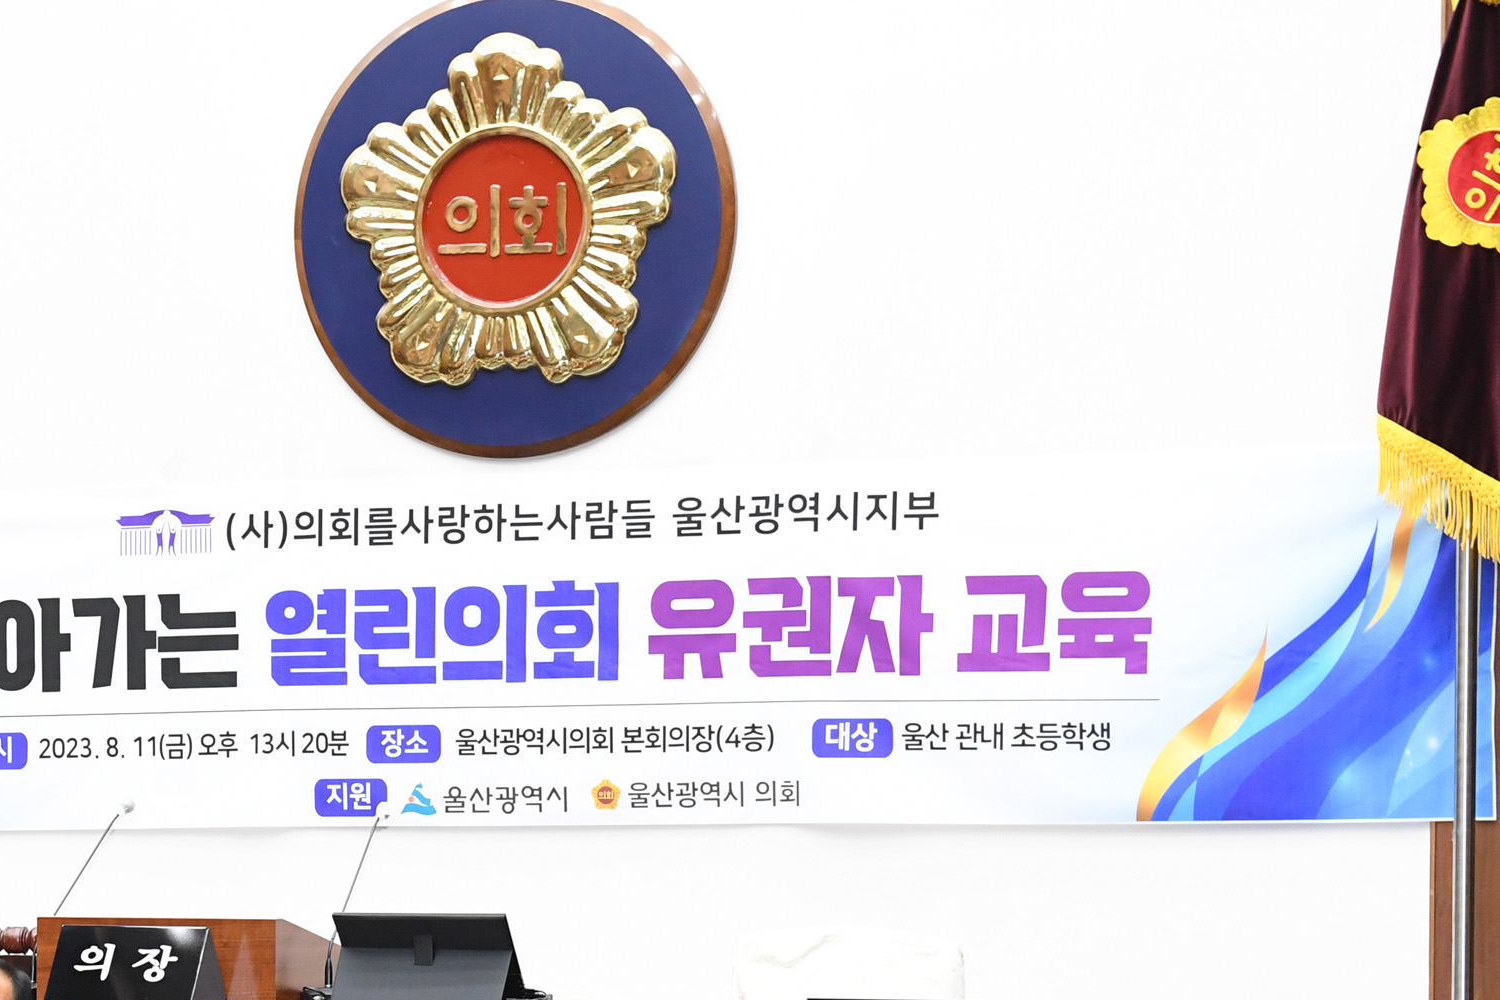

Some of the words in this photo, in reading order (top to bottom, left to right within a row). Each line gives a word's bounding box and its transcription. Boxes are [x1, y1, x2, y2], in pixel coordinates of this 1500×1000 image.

[437, 182, 567, 258] 의회
[226, 499, 656, 551] (사)의회를사랑하는사람들
[672, 490, 940, 537] 울산광역시지부
[265, 580, 619, 687] 열린의회
[647, 574, 935, 680] 유권자
[956, 570, 1153, 675] 교육
[38, 737, 100, 759] 2023.
[106, 737, 126, 758] 8.
[133, 733, 193, 761] 11(금)
[198, 731, 239, 757] 오후
[250, 730, 295, 757] 13시
[301, 730, 350, 757] 20분
[380, 728, 429, 758] 장소
[455, 726, 614, 756] 울산광역시의회
[620, 723, 774, 754] 본회의장(4층)
[825, 721, 878, 752] 대상
[901, 722, 950, 751] 울산
[955, 722, 1004, 751] 관내
[1010, 722, 1111, 752] 초등학생
[326, 781, 372, 811] 지원
[443, 785, 568, 815] 울산광역시
[628, 781, 744, 809] 울산광역시
[755, 780, 800, 807] 의회
